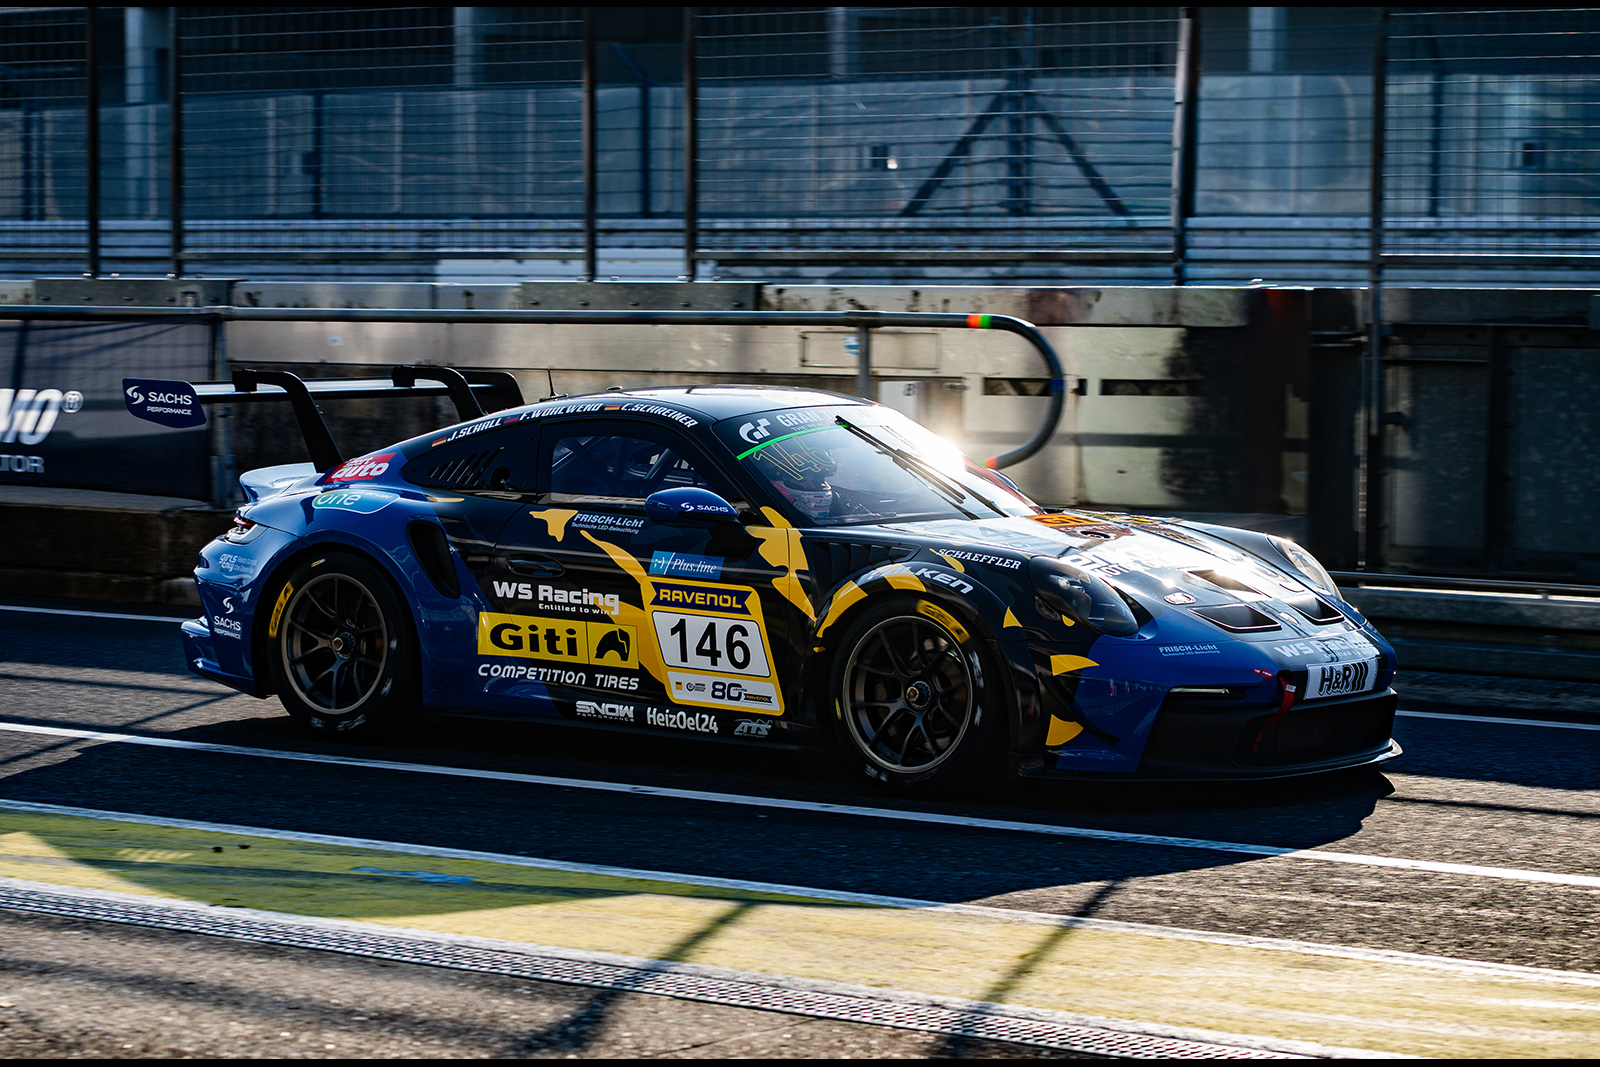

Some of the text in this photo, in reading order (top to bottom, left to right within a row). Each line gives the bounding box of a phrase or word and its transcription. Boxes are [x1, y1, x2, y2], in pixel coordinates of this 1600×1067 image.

[148, 392, 192, 405] SACHS
[147, 406, 192, 416] PERFORMANCE
[776, 410, 823, 427] GRAN
[447, 403, 698, 442] J.SCHALL F.WOHLWEND C.SCHREINER
[331, 462, 389, 479] auto
[317, 494, 361, 506] one
[574, 513, 644, 528] FRISCH-Licht
[936, 548, 1022, 570] SCHAEFFLER
[493, 581, 619, 615] WS Racing
[538, 603, 576, 612] Entitled
[659, 588, 742, 608] RAVENOL
[214, 616, 241, 631] SACHS
[490, 623, 578, 657] Giti
[670, 618, 751, 670] 146
[1274, 641, 1314, 658] WS
[478, 663, 640, 691] COMPETITION TIRES
[711, 681, 742, 701] 80
[576, 700, 635, 719] SNOW
[646, 706, 719, 733] HeizOel24
